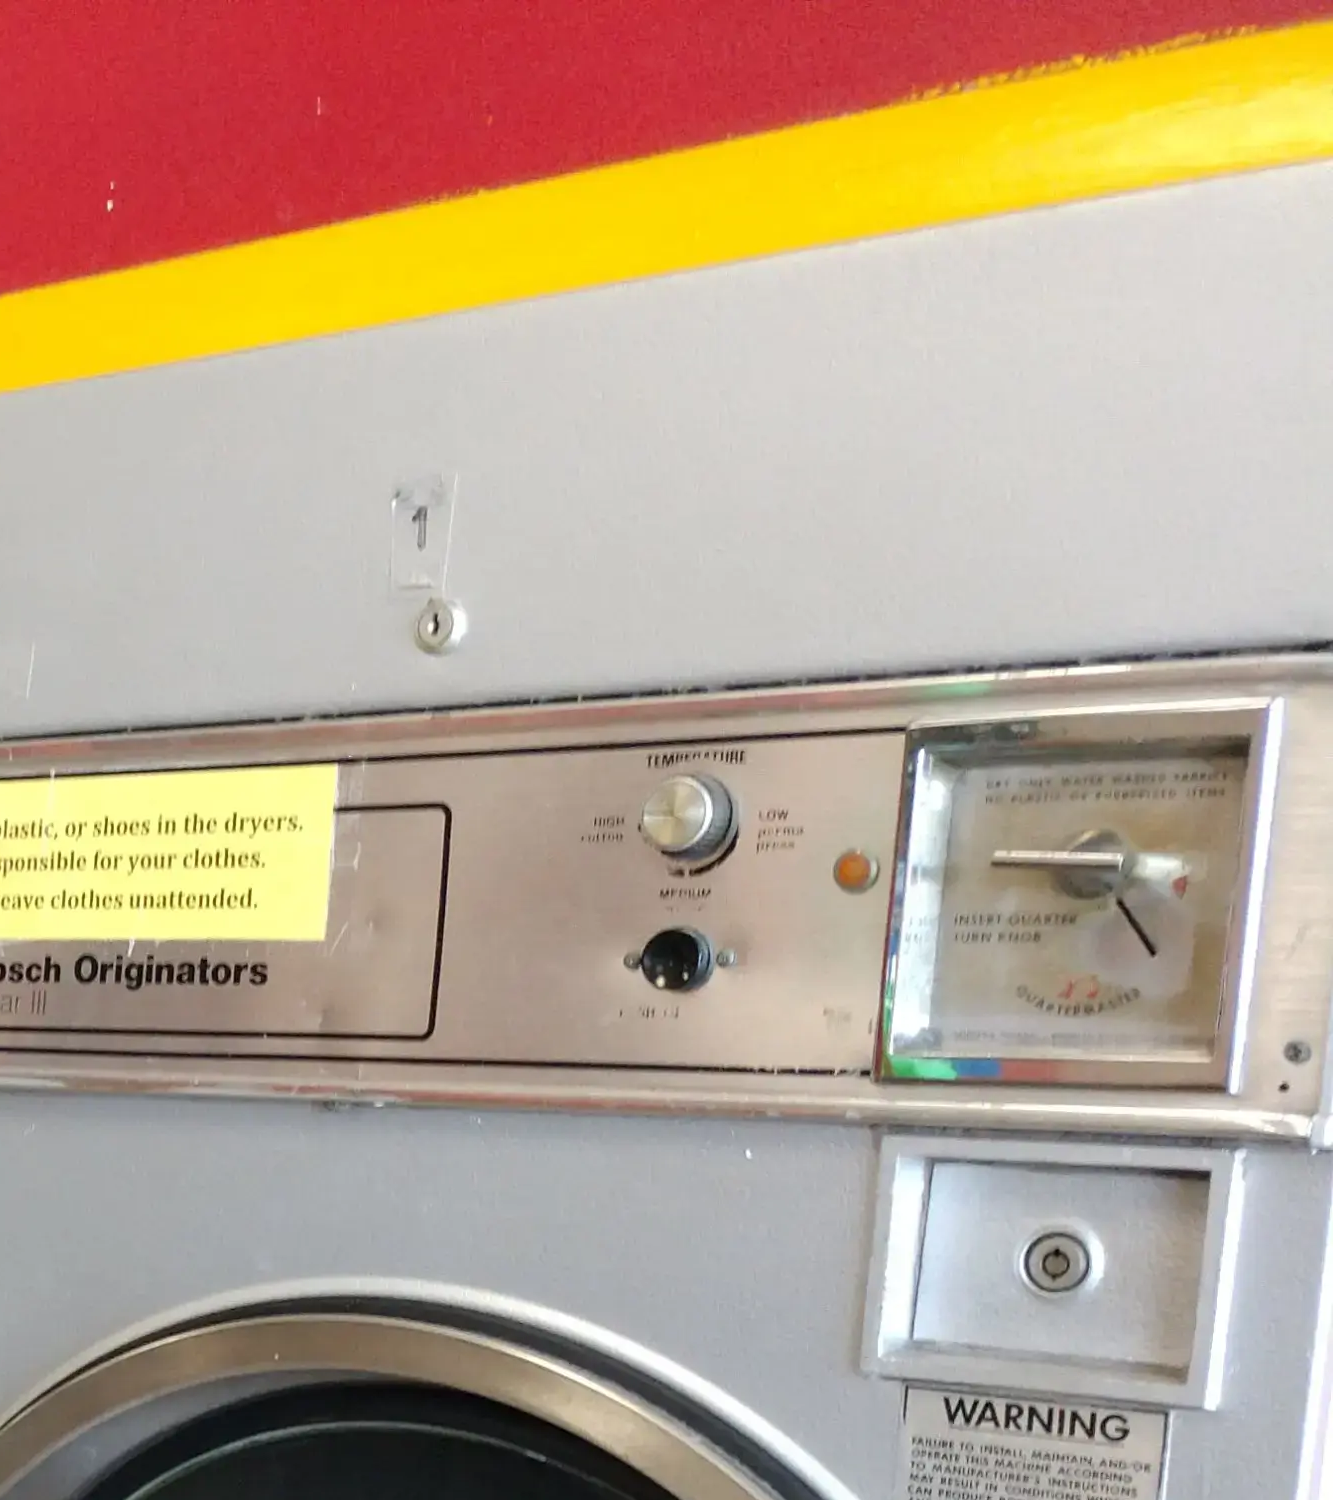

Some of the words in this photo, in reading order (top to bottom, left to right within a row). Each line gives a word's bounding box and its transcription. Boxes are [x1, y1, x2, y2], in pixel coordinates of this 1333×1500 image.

[411, 505, 429, 552] 1
[65, 820, 87, 841] or
[92, 815, 151, 837] shoes
[157, 814, 177, 836] in
[184, 813, 217, 835] the
[758, 809, 789, 821] LOW
[93, 849, 123, 871] for
[128, 852, 177, 876] your
[50, 888, 123, 910] clothes
[73, 954, 269, 991] Originators
[943, 1396, 1131, 1442] WARNING
[912, 1436, 955, 1449] FAILURE
[960, 1442, 974, 1452] TO
[910, 1460, 926, 1471] TO
[1048, 1477, 1138, 1499] INSTRUCTIONS
[911, 1448, 960, 1463] OPERATE
[966, 1454, 989, 1467] THIS
[995, 1458, 1050, 1473] MACHINE
[1058, 1466, 1133, 1484] ACCORDING
[907, 1485, 933, 1497] CAN
[909, 1473, 934, 1484] MAY
[940, 1477, 981, 1490] RESULT
[985, 1481, 998, 1492] IN
